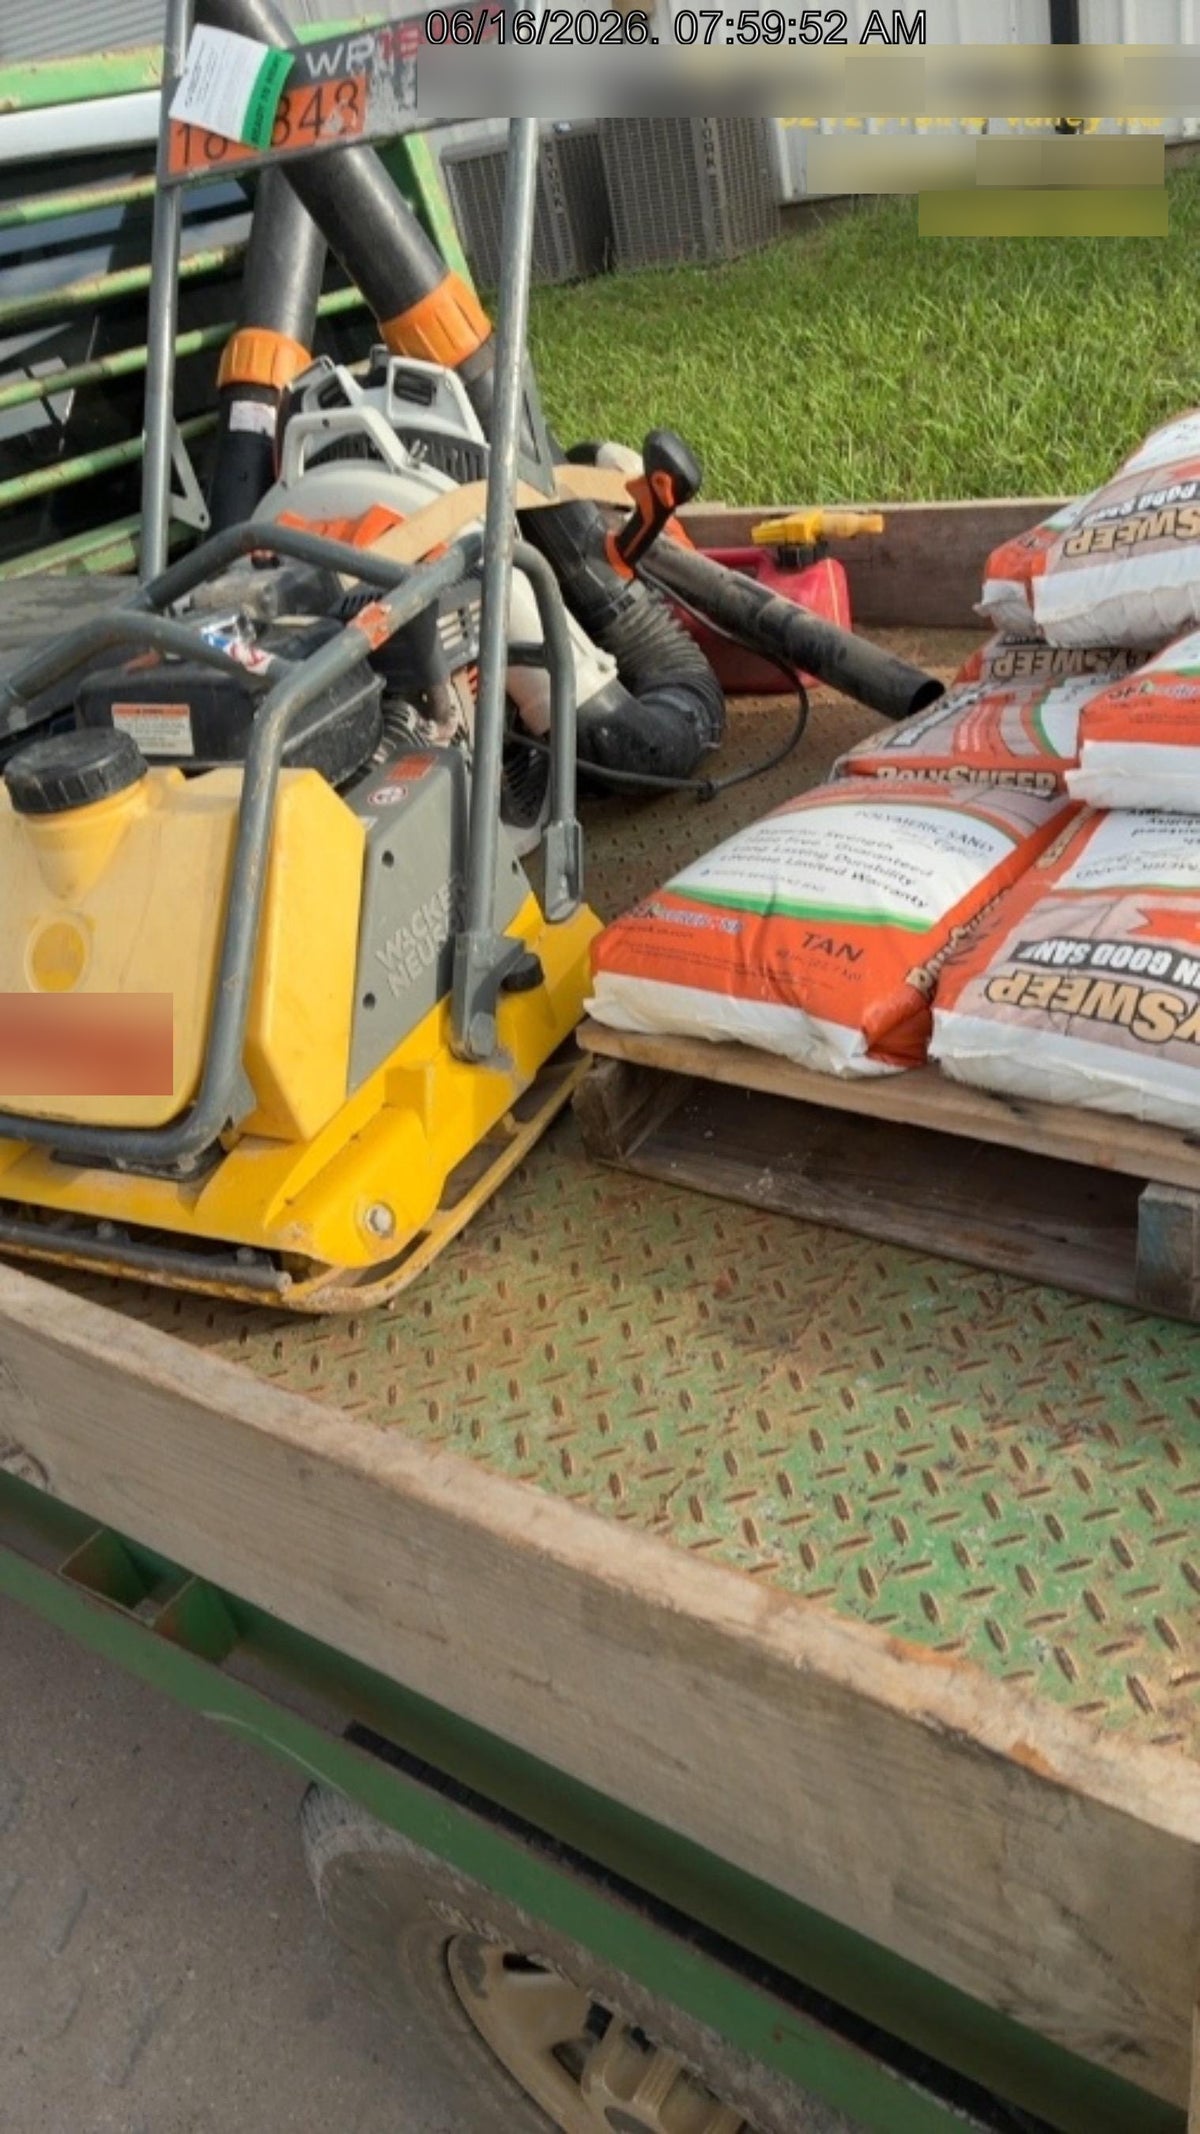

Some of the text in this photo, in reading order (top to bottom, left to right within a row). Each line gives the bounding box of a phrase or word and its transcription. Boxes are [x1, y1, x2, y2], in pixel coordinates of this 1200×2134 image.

[1062, 507, 1200, 557] SWEEP
[375, 876, 453, 973] WACKE
[802, 931, 864, 962] TAN
[1091, 943, 1173, 976] GOOD
[984, 969, 1200, 1046] YSWEEP
